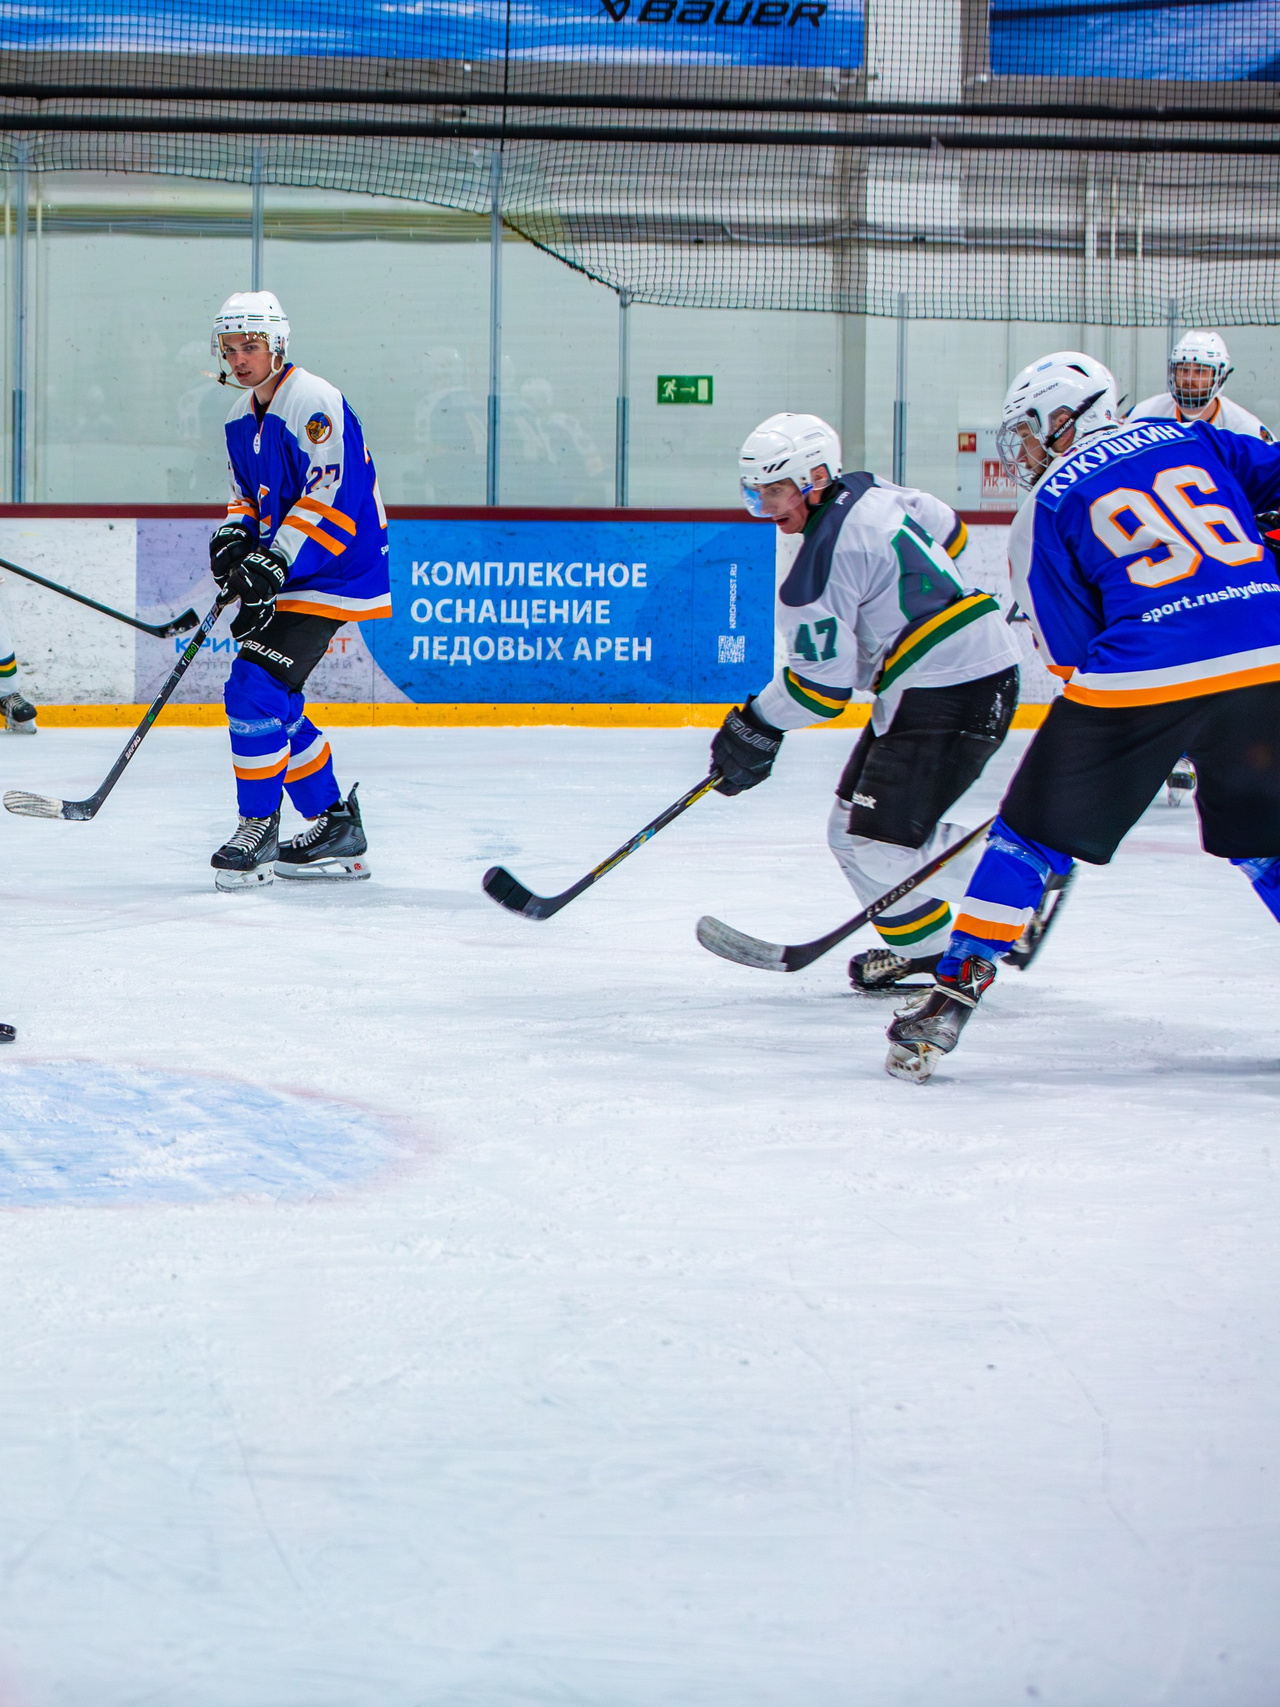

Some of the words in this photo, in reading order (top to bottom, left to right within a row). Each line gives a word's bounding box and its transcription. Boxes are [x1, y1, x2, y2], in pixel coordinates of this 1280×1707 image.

[638, 0, 828, 27] BAUER
[1043, 424, 1186, 498] КУКУШКИН
[305, 463, 340, 496] 27
[1089, 464, 1265, 589] 96
[411, 560, 648, 587] КОМПЛЕКСНОЕ
[729, 563, 738, 629] KRIOFROST.RU
[410, 597, 611, 630] ОСНАЩЕНИЕ
[243, 639, 295, 669] BAUER
[408, 635, 565, 667] ЛЕДОВЫХ
[571, 636, 653, 662] АРЕН
[793, 616, 837, 662] 47
